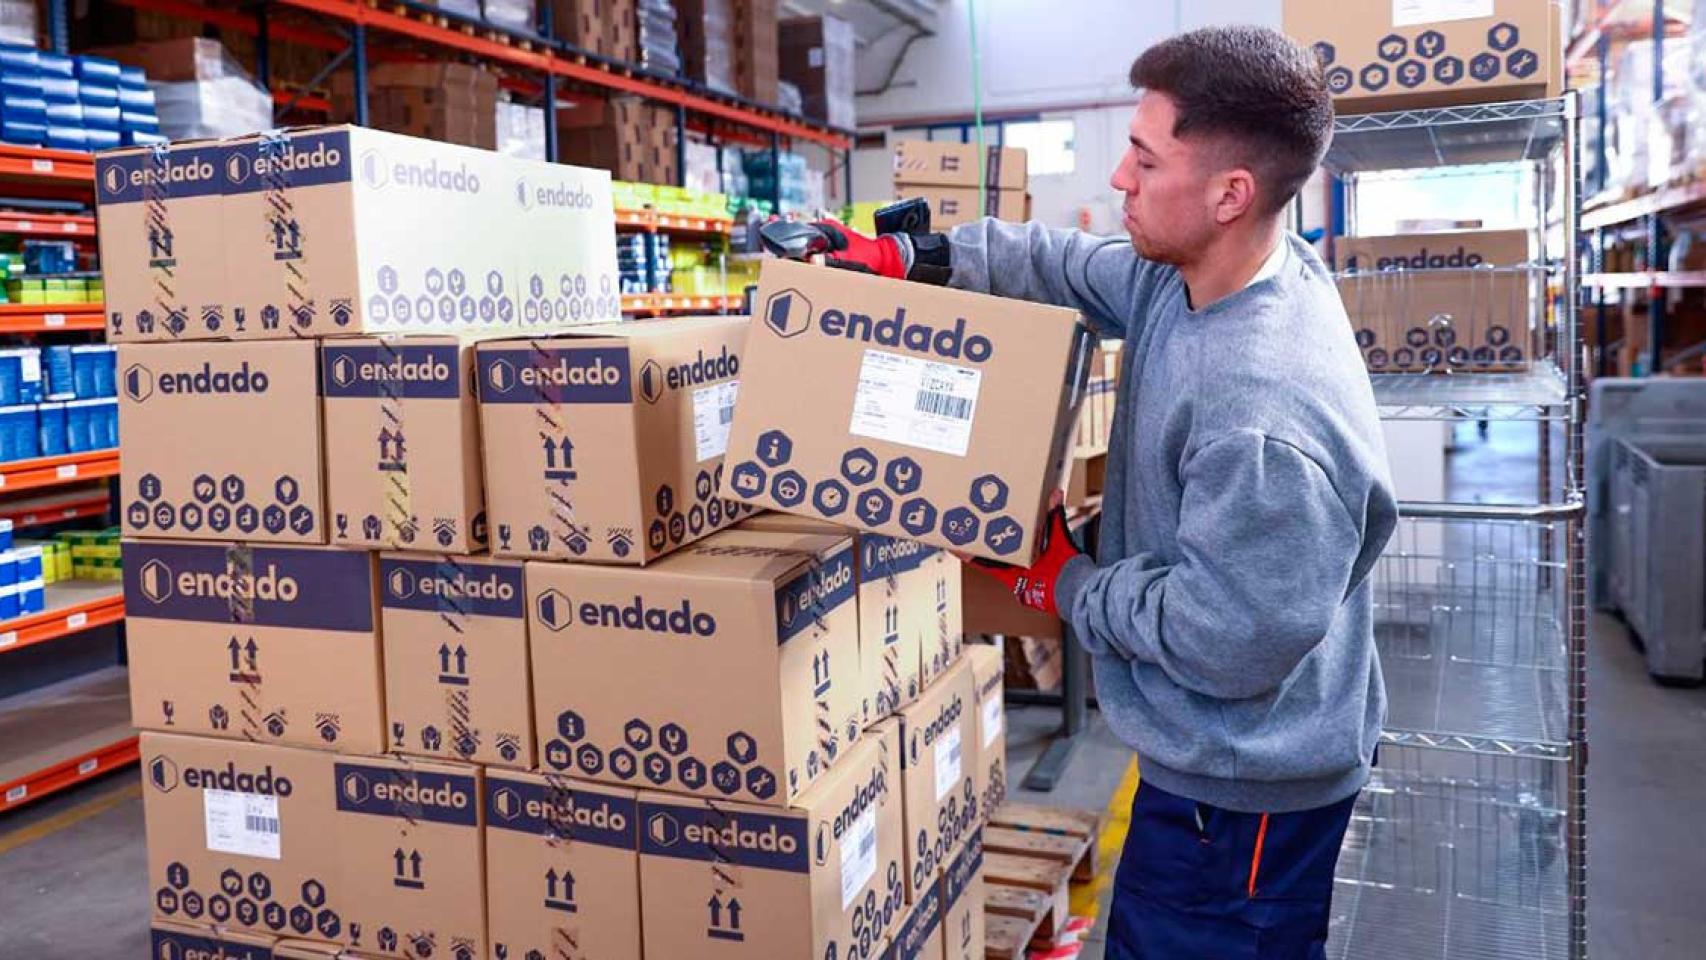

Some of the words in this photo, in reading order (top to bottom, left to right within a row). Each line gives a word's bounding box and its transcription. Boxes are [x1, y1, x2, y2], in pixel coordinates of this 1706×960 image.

[253, 142, 341, 175] endado
[393, 160, 480, 194] endado
[536, 182, 594, 209] endado
[819, 307, 993, 363] endado
[159, 361, 269, 394] endado
[360, 354, 449, 381] endado
[520, 356, 620, 385] endado
[667, 345, 739, 389] endado
[177, 560, 298, 602] endado
[420, 573, 514, 600] endado
[579, 595, 716, 637] endado
[925, 692, 962, 746] endado
[184, 762, 292, 797] endado
[374, 779, 467, 809] endado
[526, 797, 626, 831] endado
[833, 766, 884, 839] endado
[684, 820, 797, 853] endado
